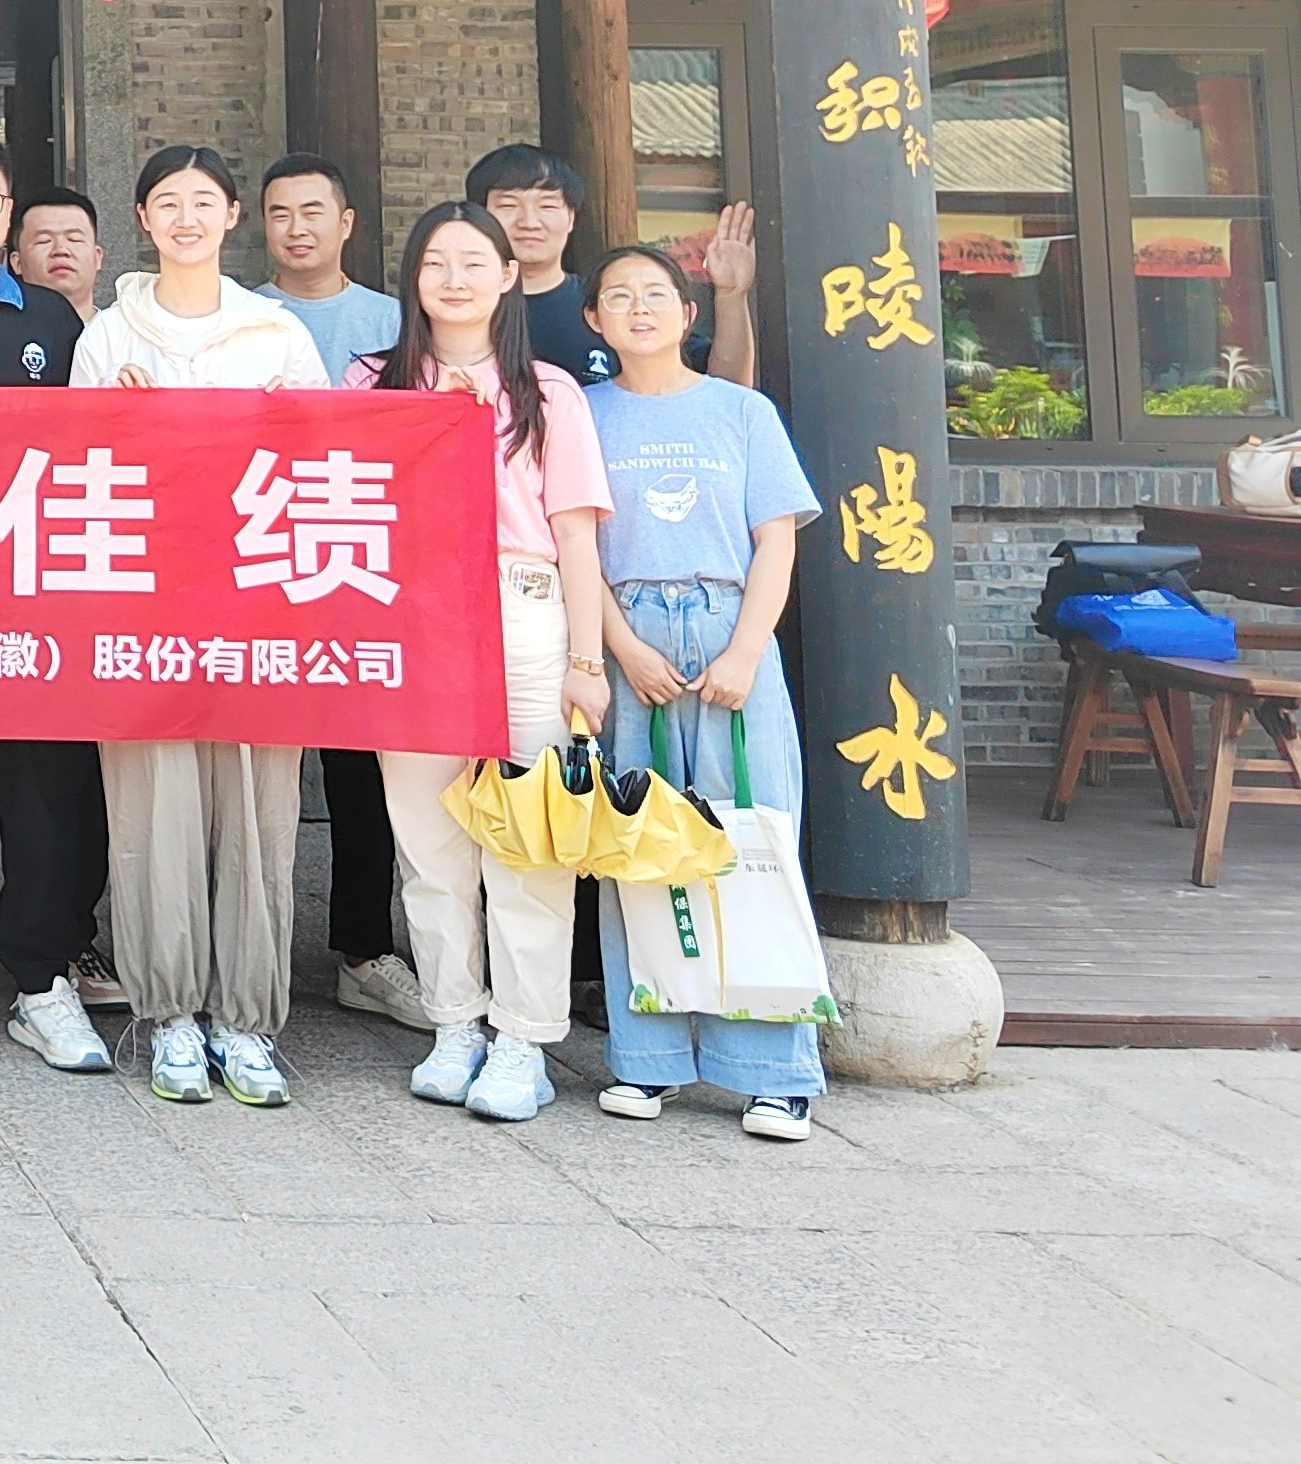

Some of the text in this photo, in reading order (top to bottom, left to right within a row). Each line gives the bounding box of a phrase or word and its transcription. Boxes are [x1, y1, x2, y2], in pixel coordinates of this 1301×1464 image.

[638, 442, 695, 455] SMITH
[607, 456, 730, 473] SANDWICH BAR
[671, 883, 697, 950] 保集团
